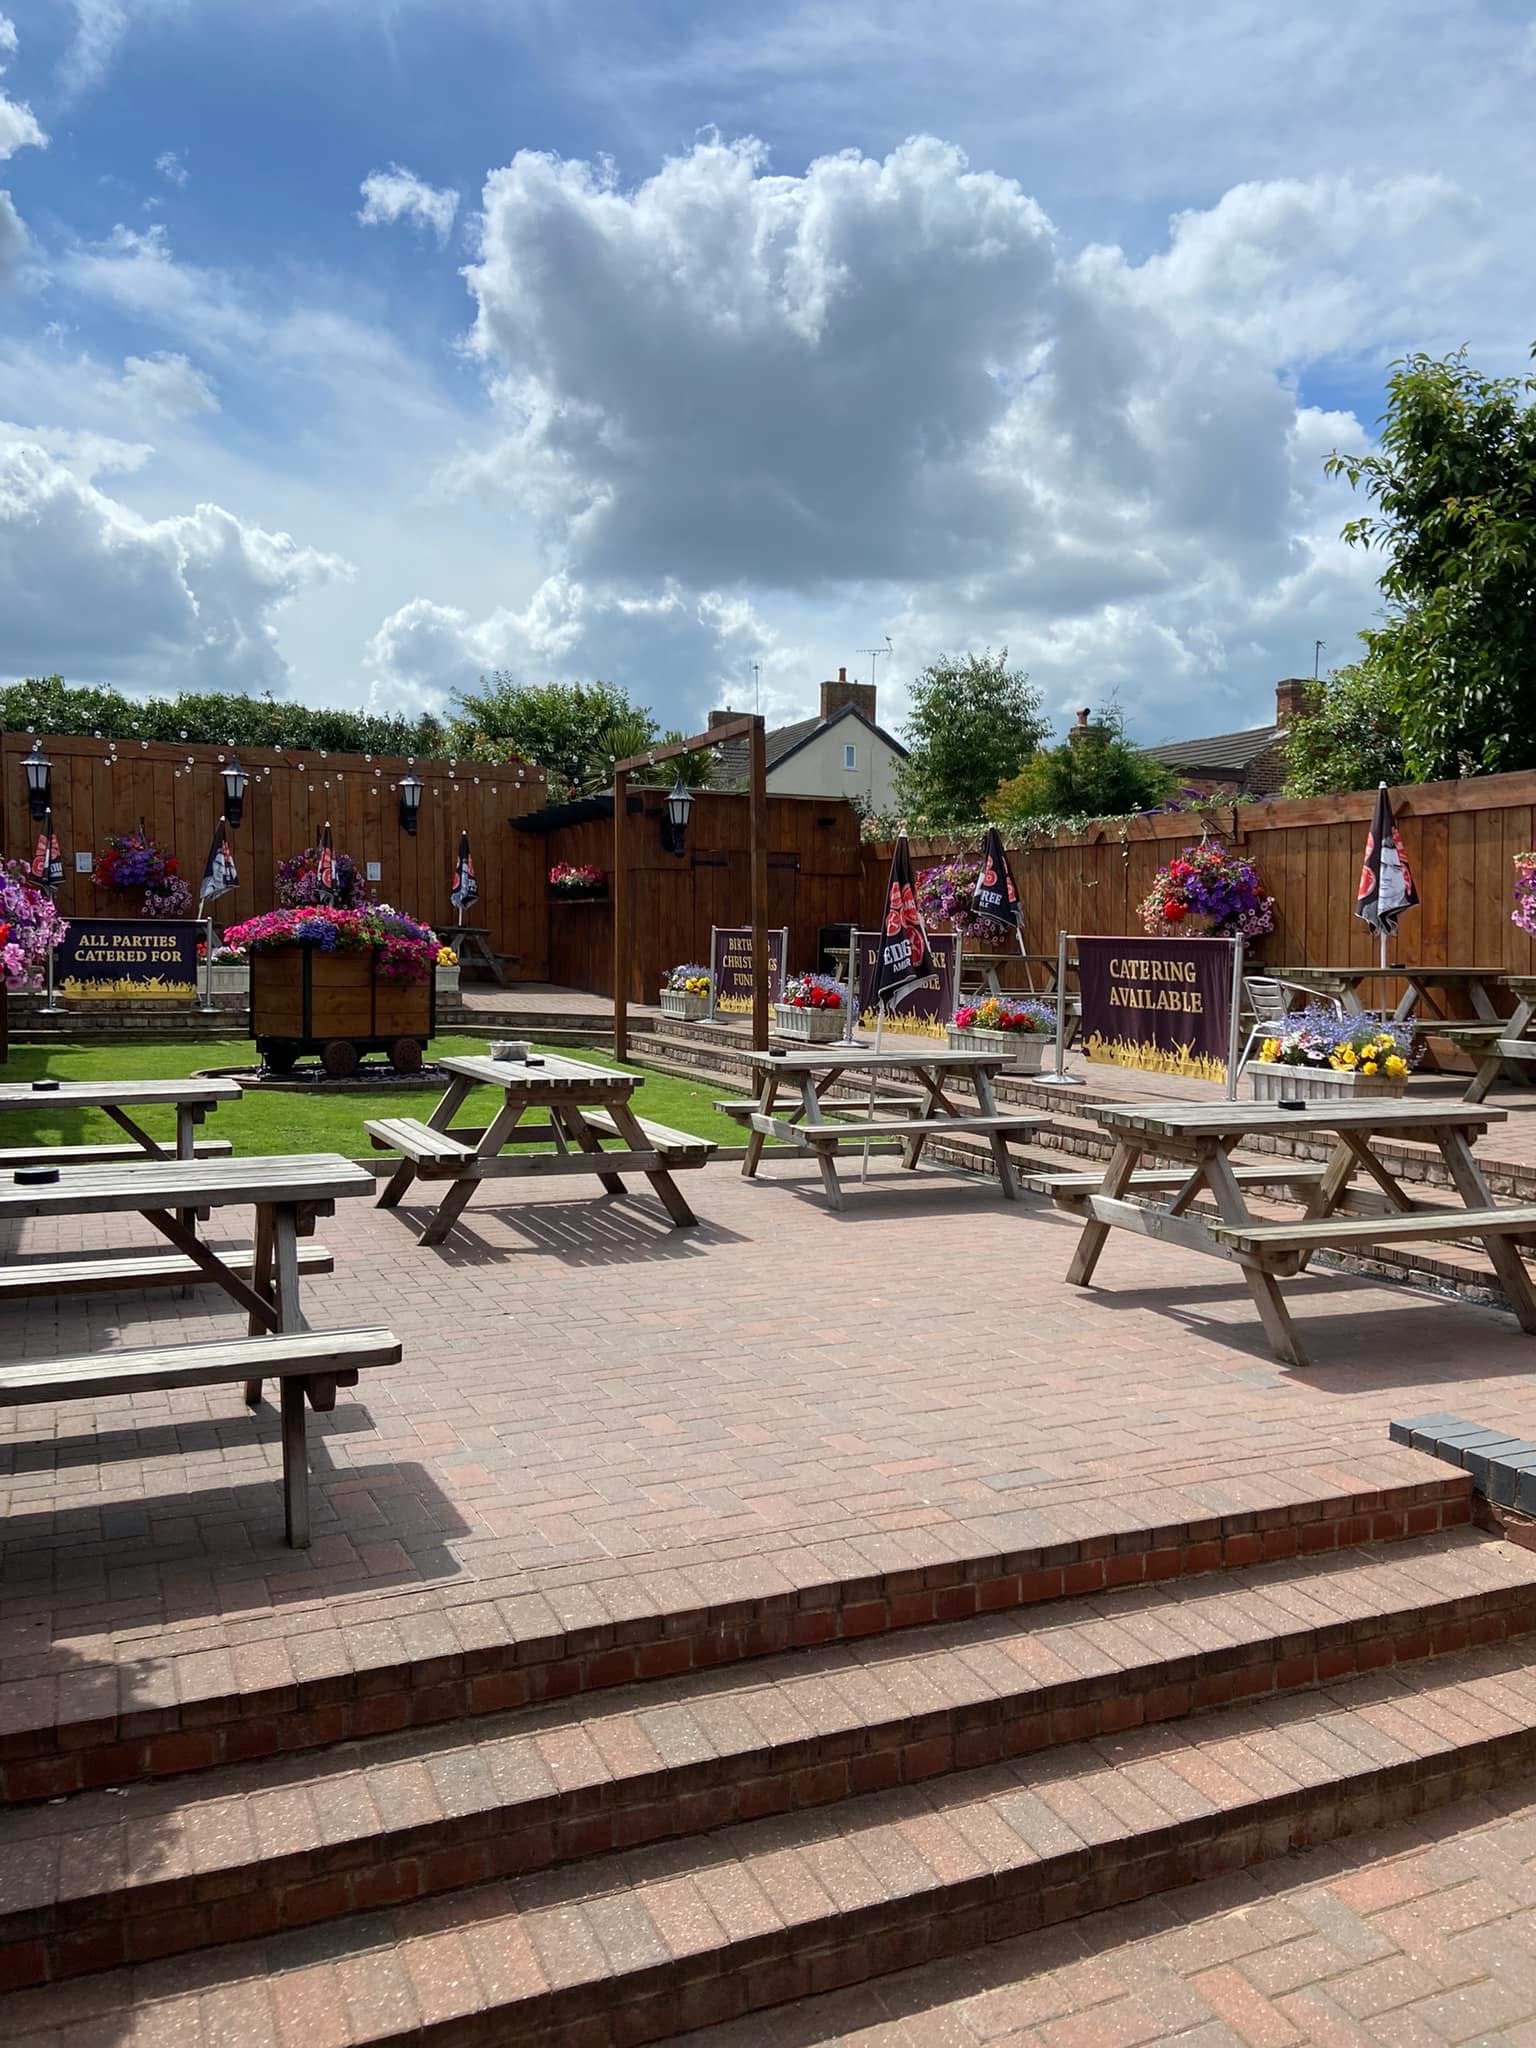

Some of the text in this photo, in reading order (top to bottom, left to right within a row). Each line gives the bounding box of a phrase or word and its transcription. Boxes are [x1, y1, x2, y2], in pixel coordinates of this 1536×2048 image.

[79, 935, 177, 948] ALL PARTIES
[74, 950, 183, 963] CATERED FOR
[1109, 959, 1197, 983] CATERING
[1109, 986, 1204, 1014] AVAILABLE
